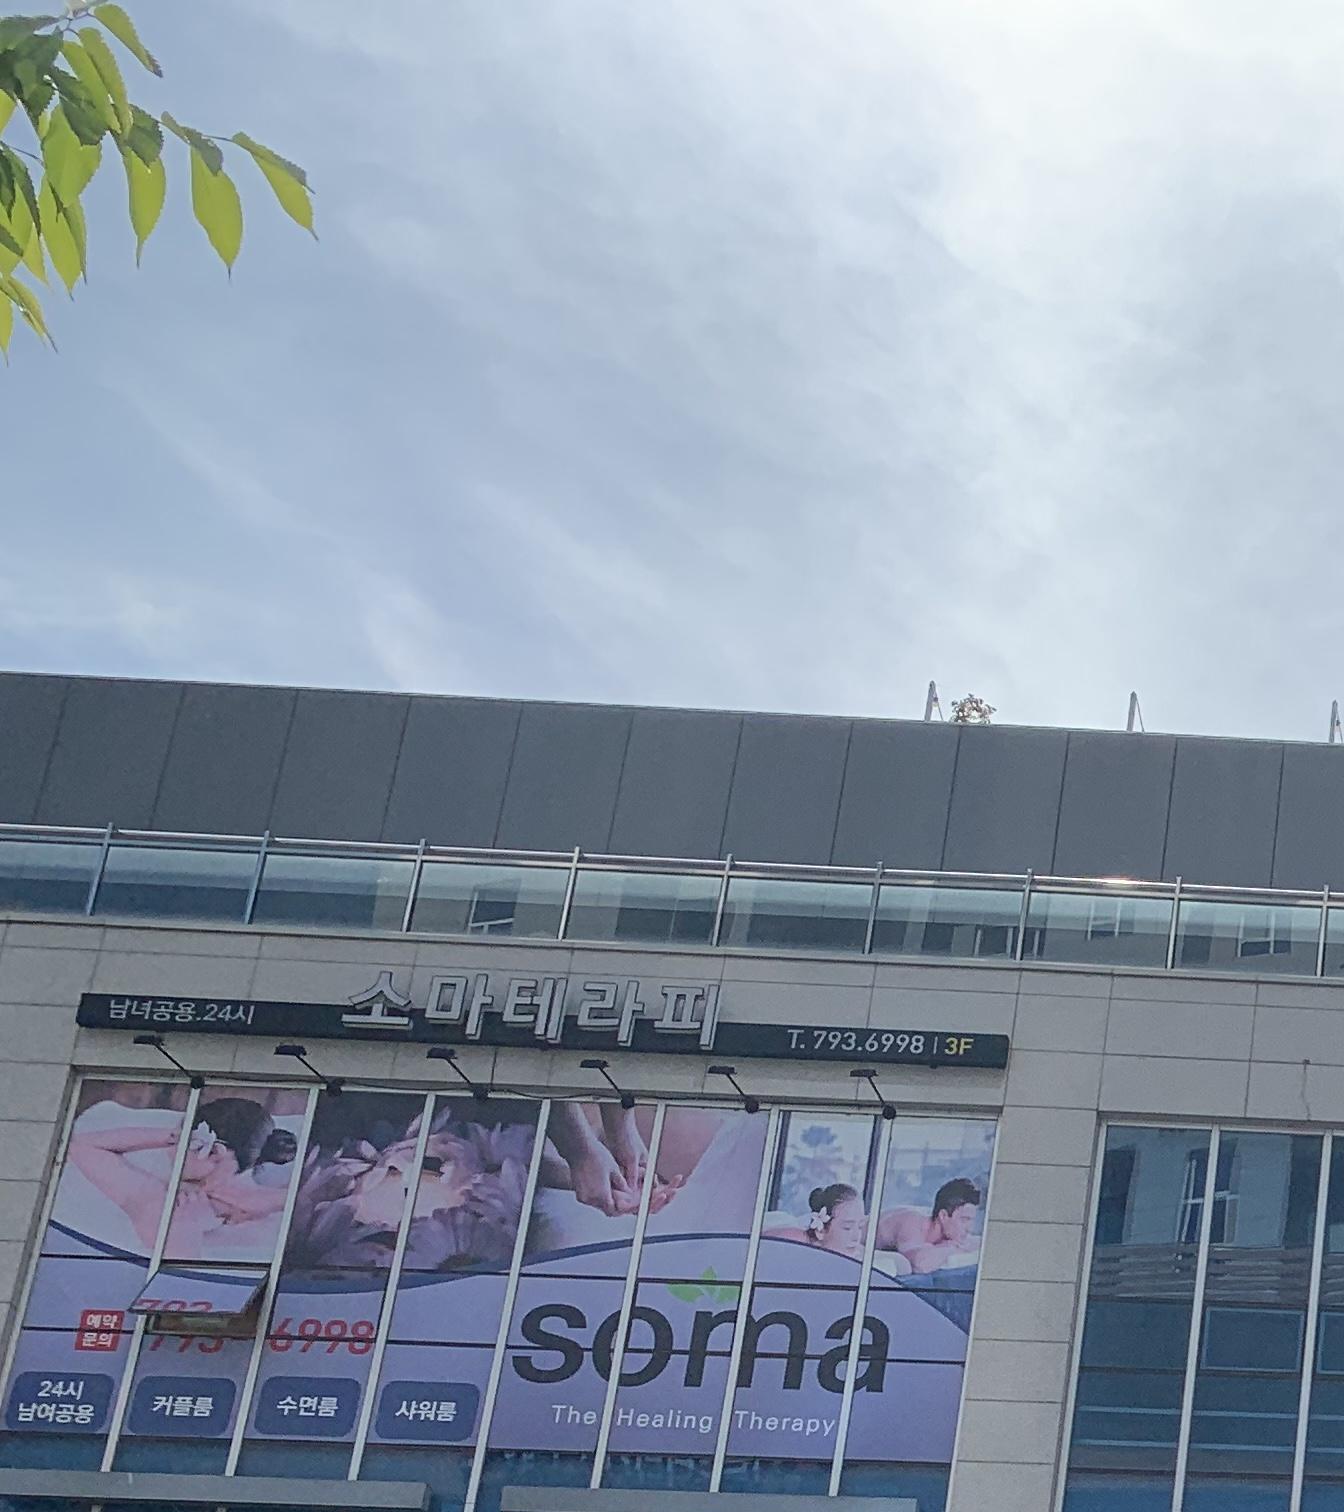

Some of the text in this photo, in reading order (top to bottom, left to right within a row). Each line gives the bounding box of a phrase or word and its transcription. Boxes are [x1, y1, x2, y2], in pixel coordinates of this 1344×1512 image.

[342, 971, 721, 1051] 소마테라피
[812, 1030, 925, 1054] 793.6998
[943, 1036, 975, 1057] 3F
[512, 1303, 890, 1393] soma
[38, 1380, 84, 1401] 24시
[151, 1395, 214, 1418] 커플룸
[276, 1396, 339, 1419] 수면룸
[395, 1400, 458, 1422] 샤워룸
[552, 1404, 836, 1437] The Healing Therapy
